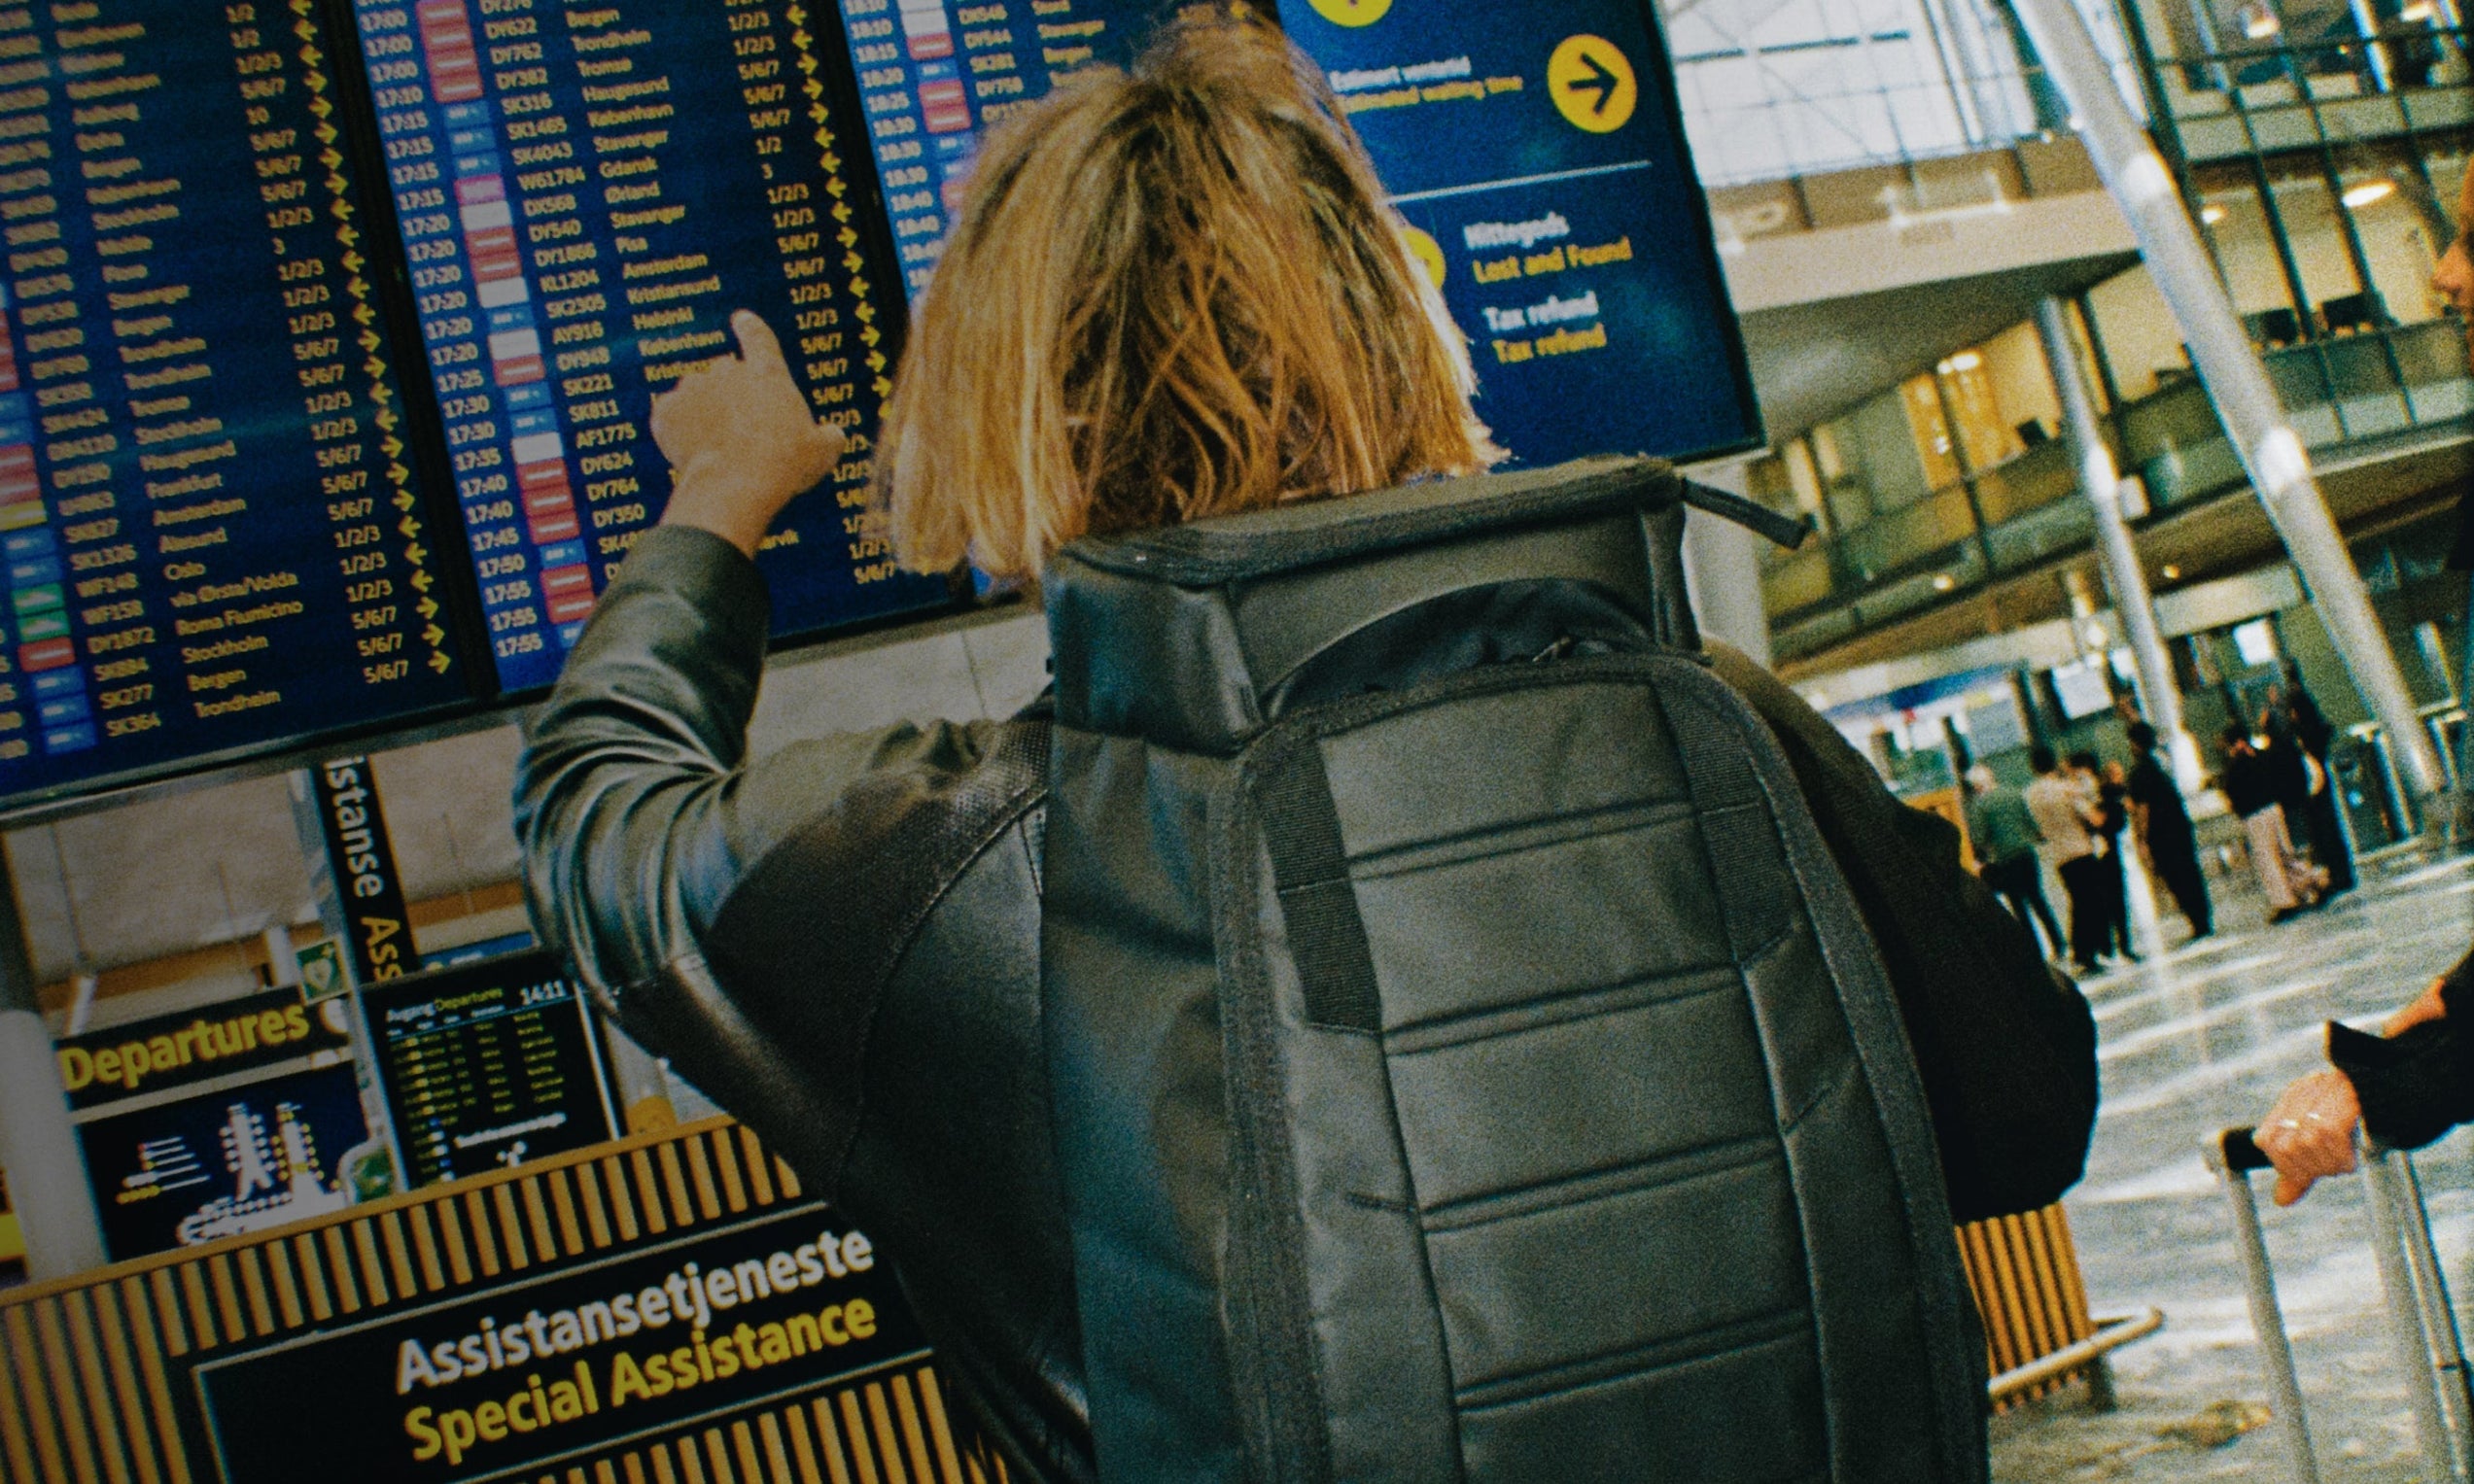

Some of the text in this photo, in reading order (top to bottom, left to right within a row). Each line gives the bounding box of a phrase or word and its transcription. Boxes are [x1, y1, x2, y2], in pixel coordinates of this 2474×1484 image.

[570, 29, 650, 52] Trondheim
[581, 76, 669, 101] Haugesund
[592, 129, 668, 153] Stavanger
[610, 204, 684, 228] Stavanger
[767, 183, 809, 203] 1/2/3
[614, 236, 647, 253] Pisa
[772, 207, 815, 227] 1/2/3
[277, 258, 324, 280] 1/2/3
[622, 254, 708, 278] Amsterdam
[777, 231, 819, 253] 5/6/7
[783, 257, 824, 278] 5/6/7
[1473, 235, 1633, 284] Lost and Found
[282, 284, 330, 307] 1/2/3
[789, 282, 831, 303] 1/2/3
[1482, 290, 1599, 332] Tax refund
[288, 311, 334, 333] 1/2/3
[795, 308, 838, 329] 1/2/3
[293, 337, 338, 360] 5/6/7
[1492, 323, 1607, 364] Tax refund
[298, 363, 344, 387] 5/6/7
[442, 332, 841, 418] 17:30 SK221 5/6/7
[305, 390, 351, 413] 1/2/3
[448, 421, 495, 444] 17:30
[806, 357, 848, 379] 5/6/7
[310, 417, 357, 440] 1/2/3
[454, 383, 853, 471] 17:35 AF1775 5/6/7
[315, 443, 361, 466] 5/6/7
[460, 451, 633, 498] 17:40 DY624
[153, 470, 366, 526] Amsterdam 5/6/7
[327, 498, 372, 520] 5/6/7
[466, 477, 639, 524] 17:40 DY764
[471, 502, 646, 551] 17:45 DY350
[162, 525, 380, 580] Oslo 1/2/3
[339, 551, 386, 574] 1/2/3
[477, 553, 525, 577] 17:50
[175, 616, 224, 635] Roma
[223, 601, 302, 625] Fiumicino
[345, 578, 392, 602] 1/2/3
[484, 579, 531, 604] 17:55
[496, 560, 895, 657] 17:55 5/6/7
[181, 636, 267, 663] Stockholm
[351, 605, 396, 629] 5/6/7
[490, 606, 537, 631] 17:55
[187, 669, 246, 691] Bergen
[357, 633, 401, 656] 5/6/7
[193, 691, 280, 717] Trondheim
[363, 659, 408, 683] 5/6/7
[435, 987, 504, 1012] Departures
[60, 1005, 310, 1091] Departures
[397, 1228, 876, 1395] Assistansetjeneste
[404, 1297, 878, 1467] Special Assistance
